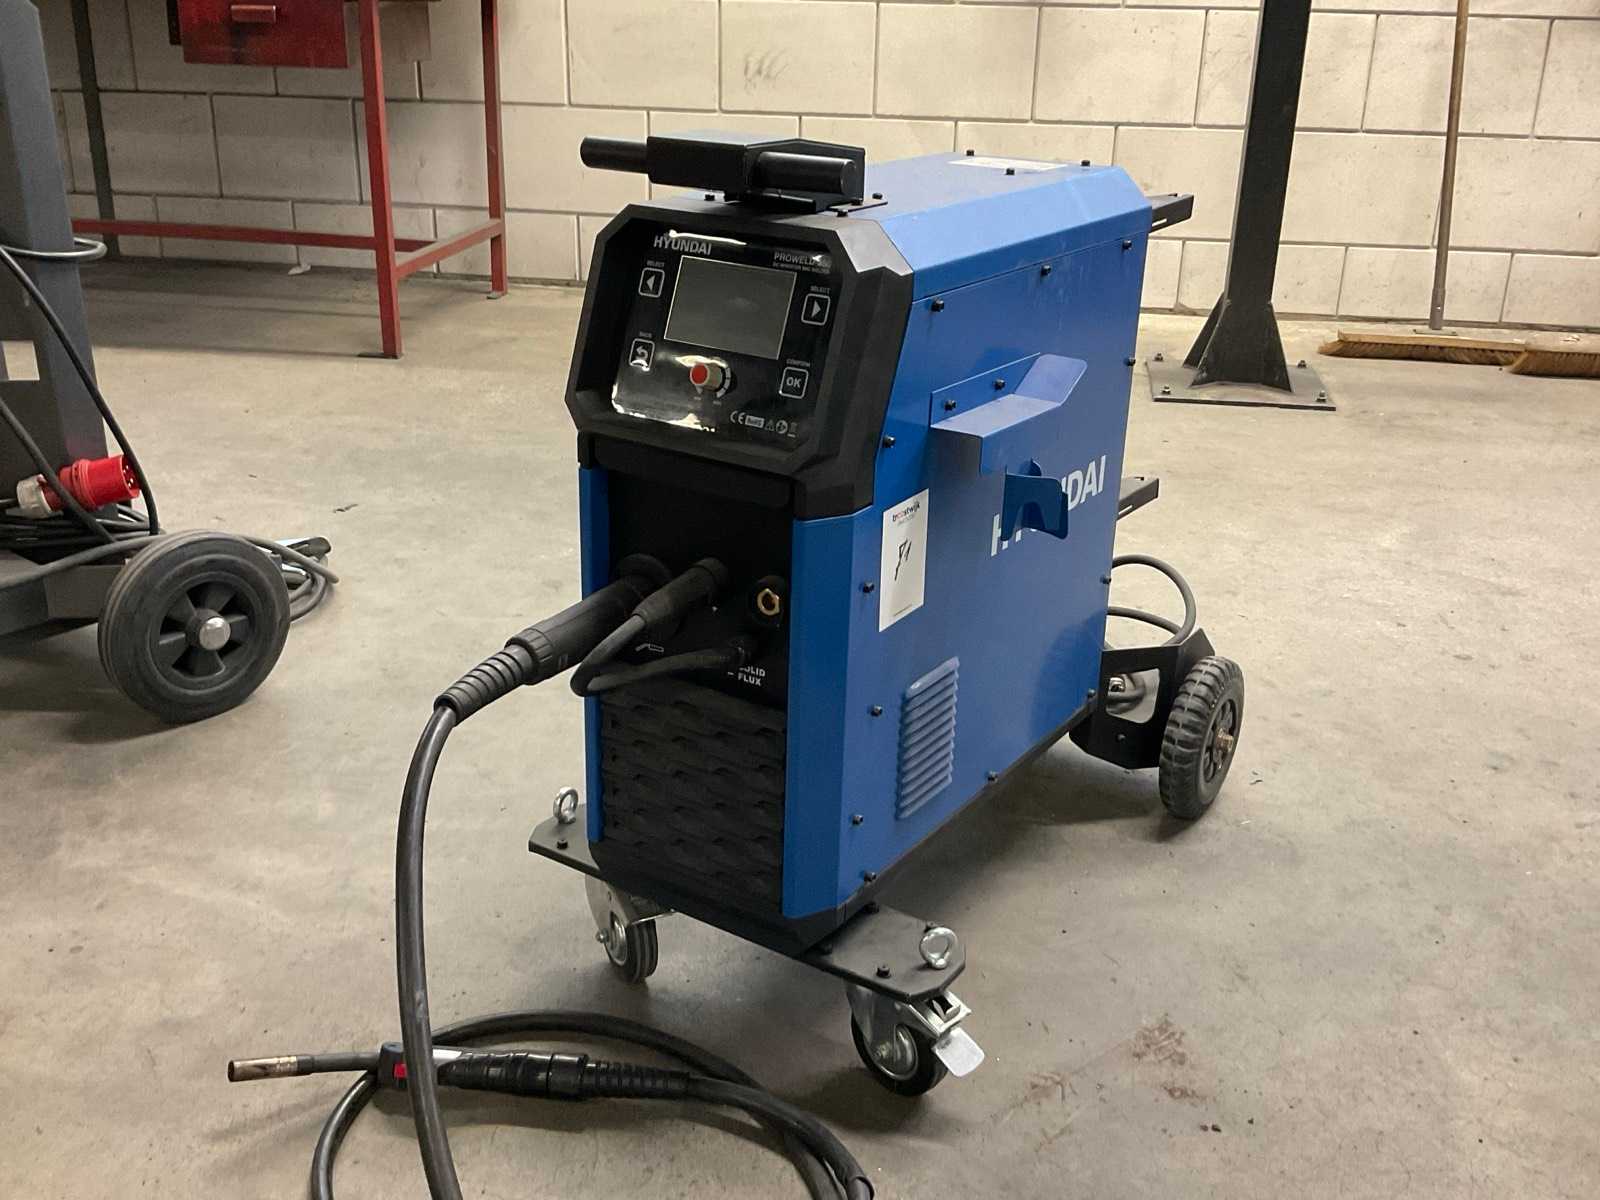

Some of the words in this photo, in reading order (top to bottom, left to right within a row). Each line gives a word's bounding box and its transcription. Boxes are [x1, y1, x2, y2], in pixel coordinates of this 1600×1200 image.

[653, 234, 713, 256] HYUNDAI
[786, 376, 802, 388] OK
[737, 672, 762, 687] FLUX
